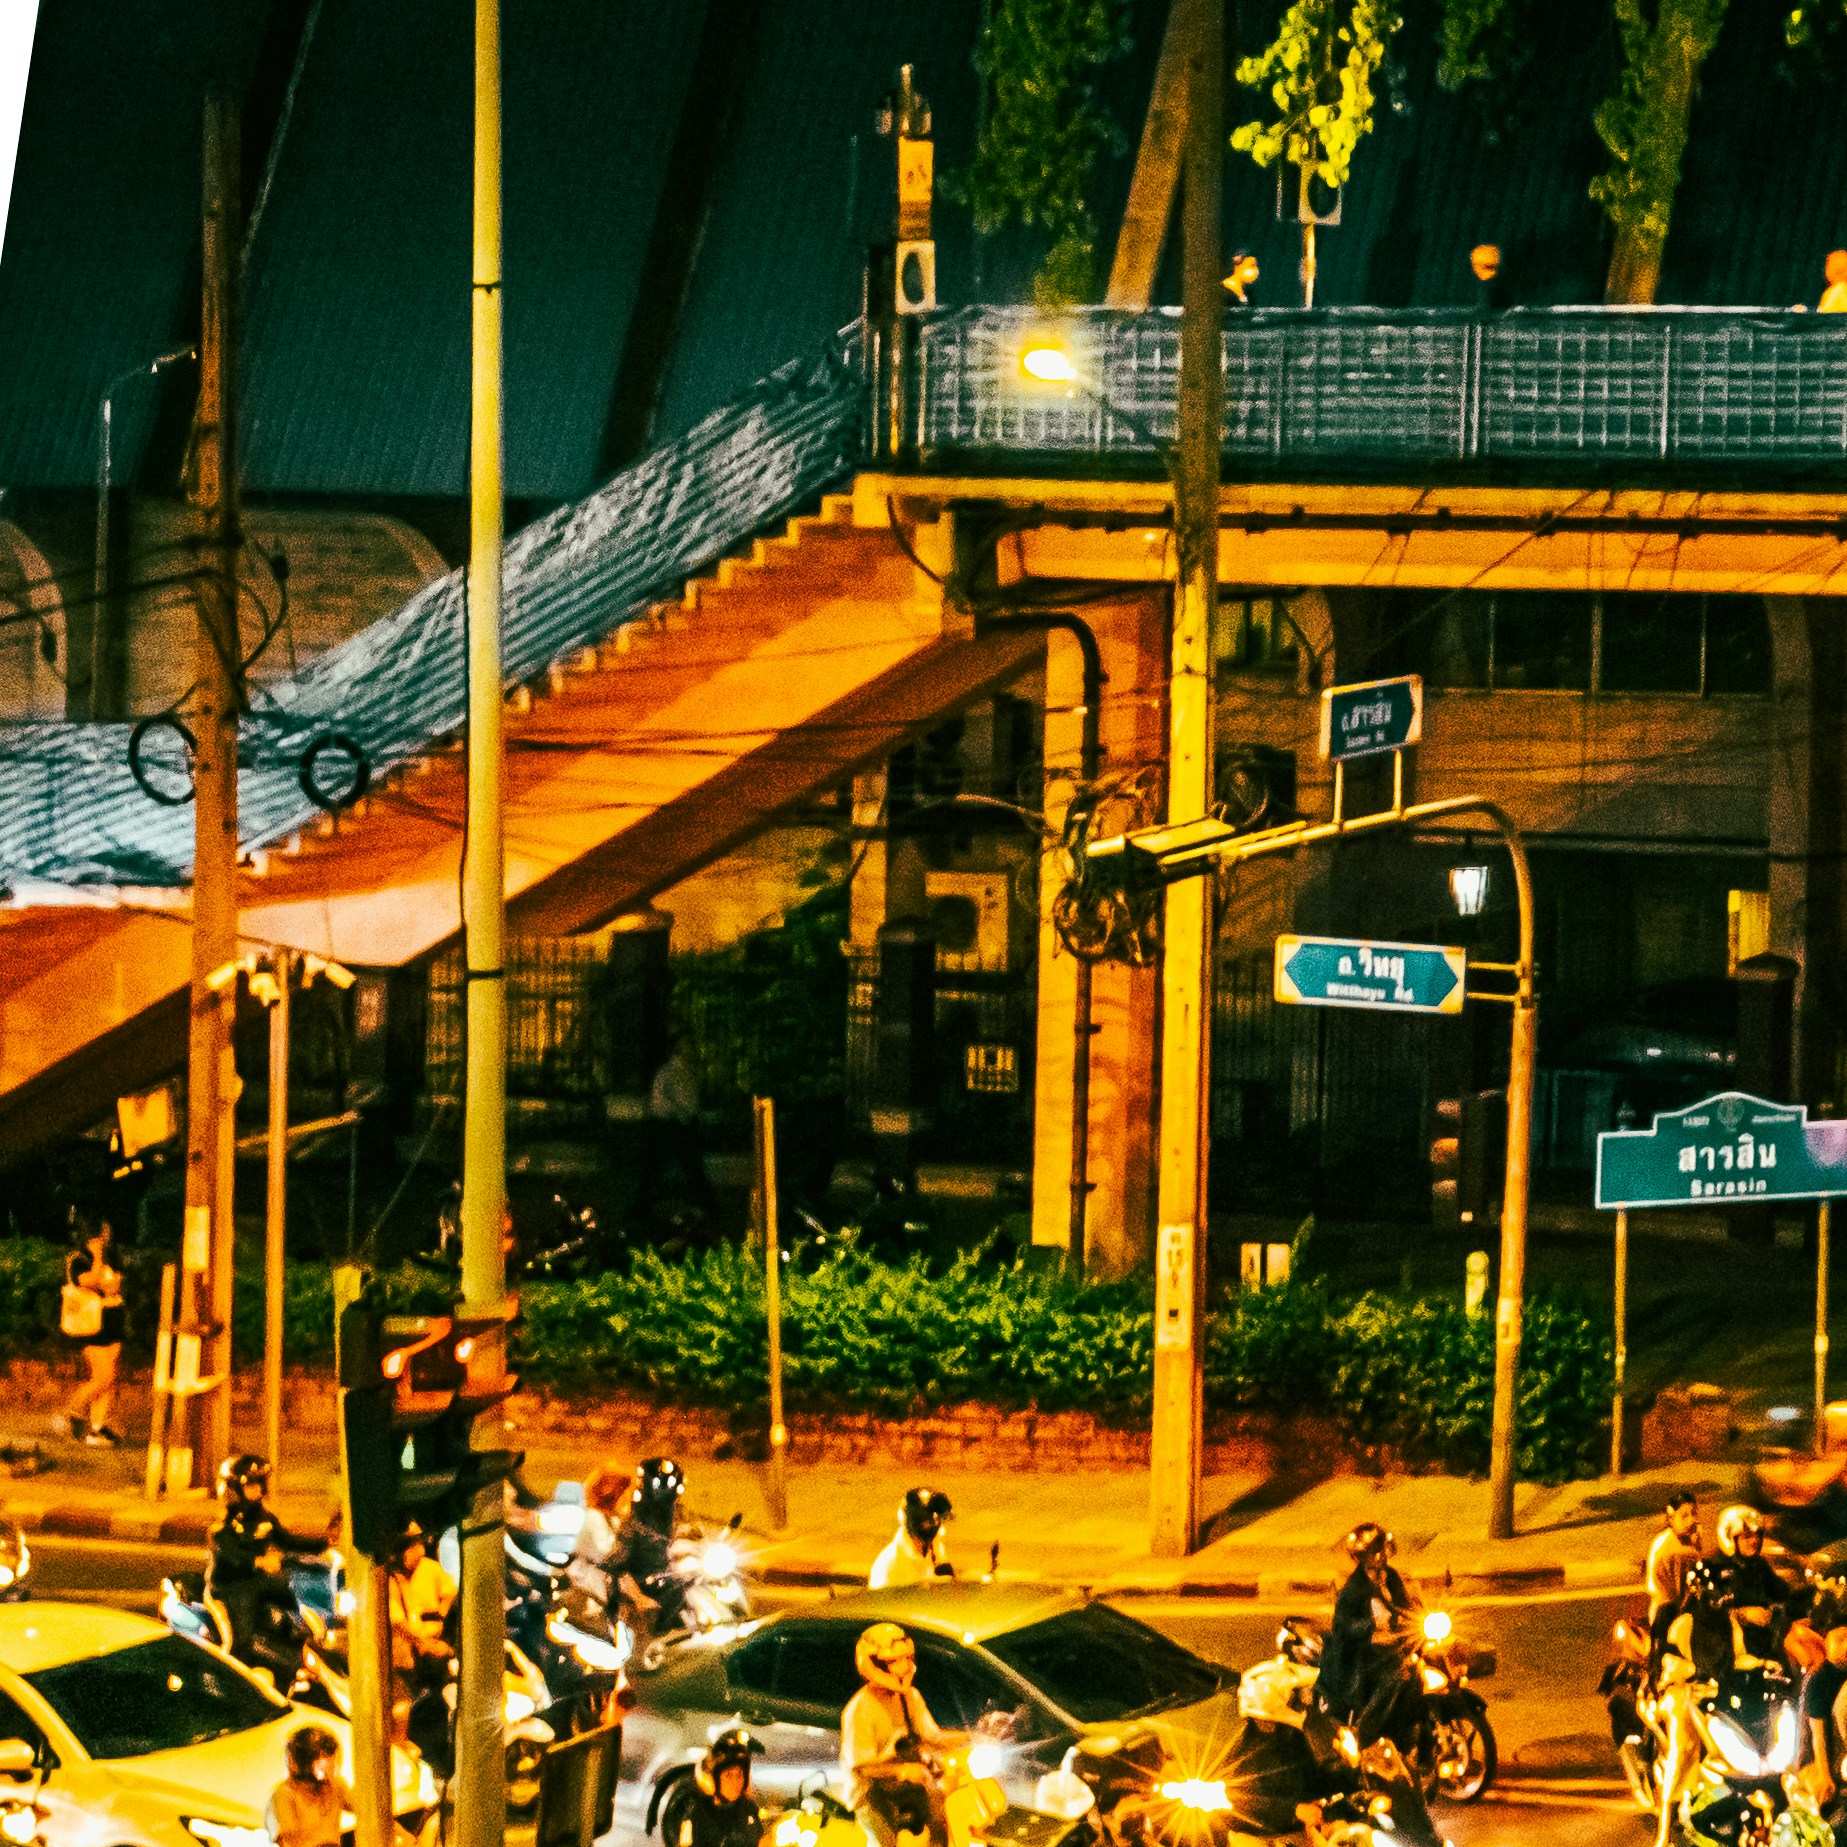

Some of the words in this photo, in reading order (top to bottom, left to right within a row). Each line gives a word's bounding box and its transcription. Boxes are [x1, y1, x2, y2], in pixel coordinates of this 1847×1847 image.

[1678, 1132, 1777, 1172] สารสิน
[1690, 1178, 1767, 1196] Sarasin
